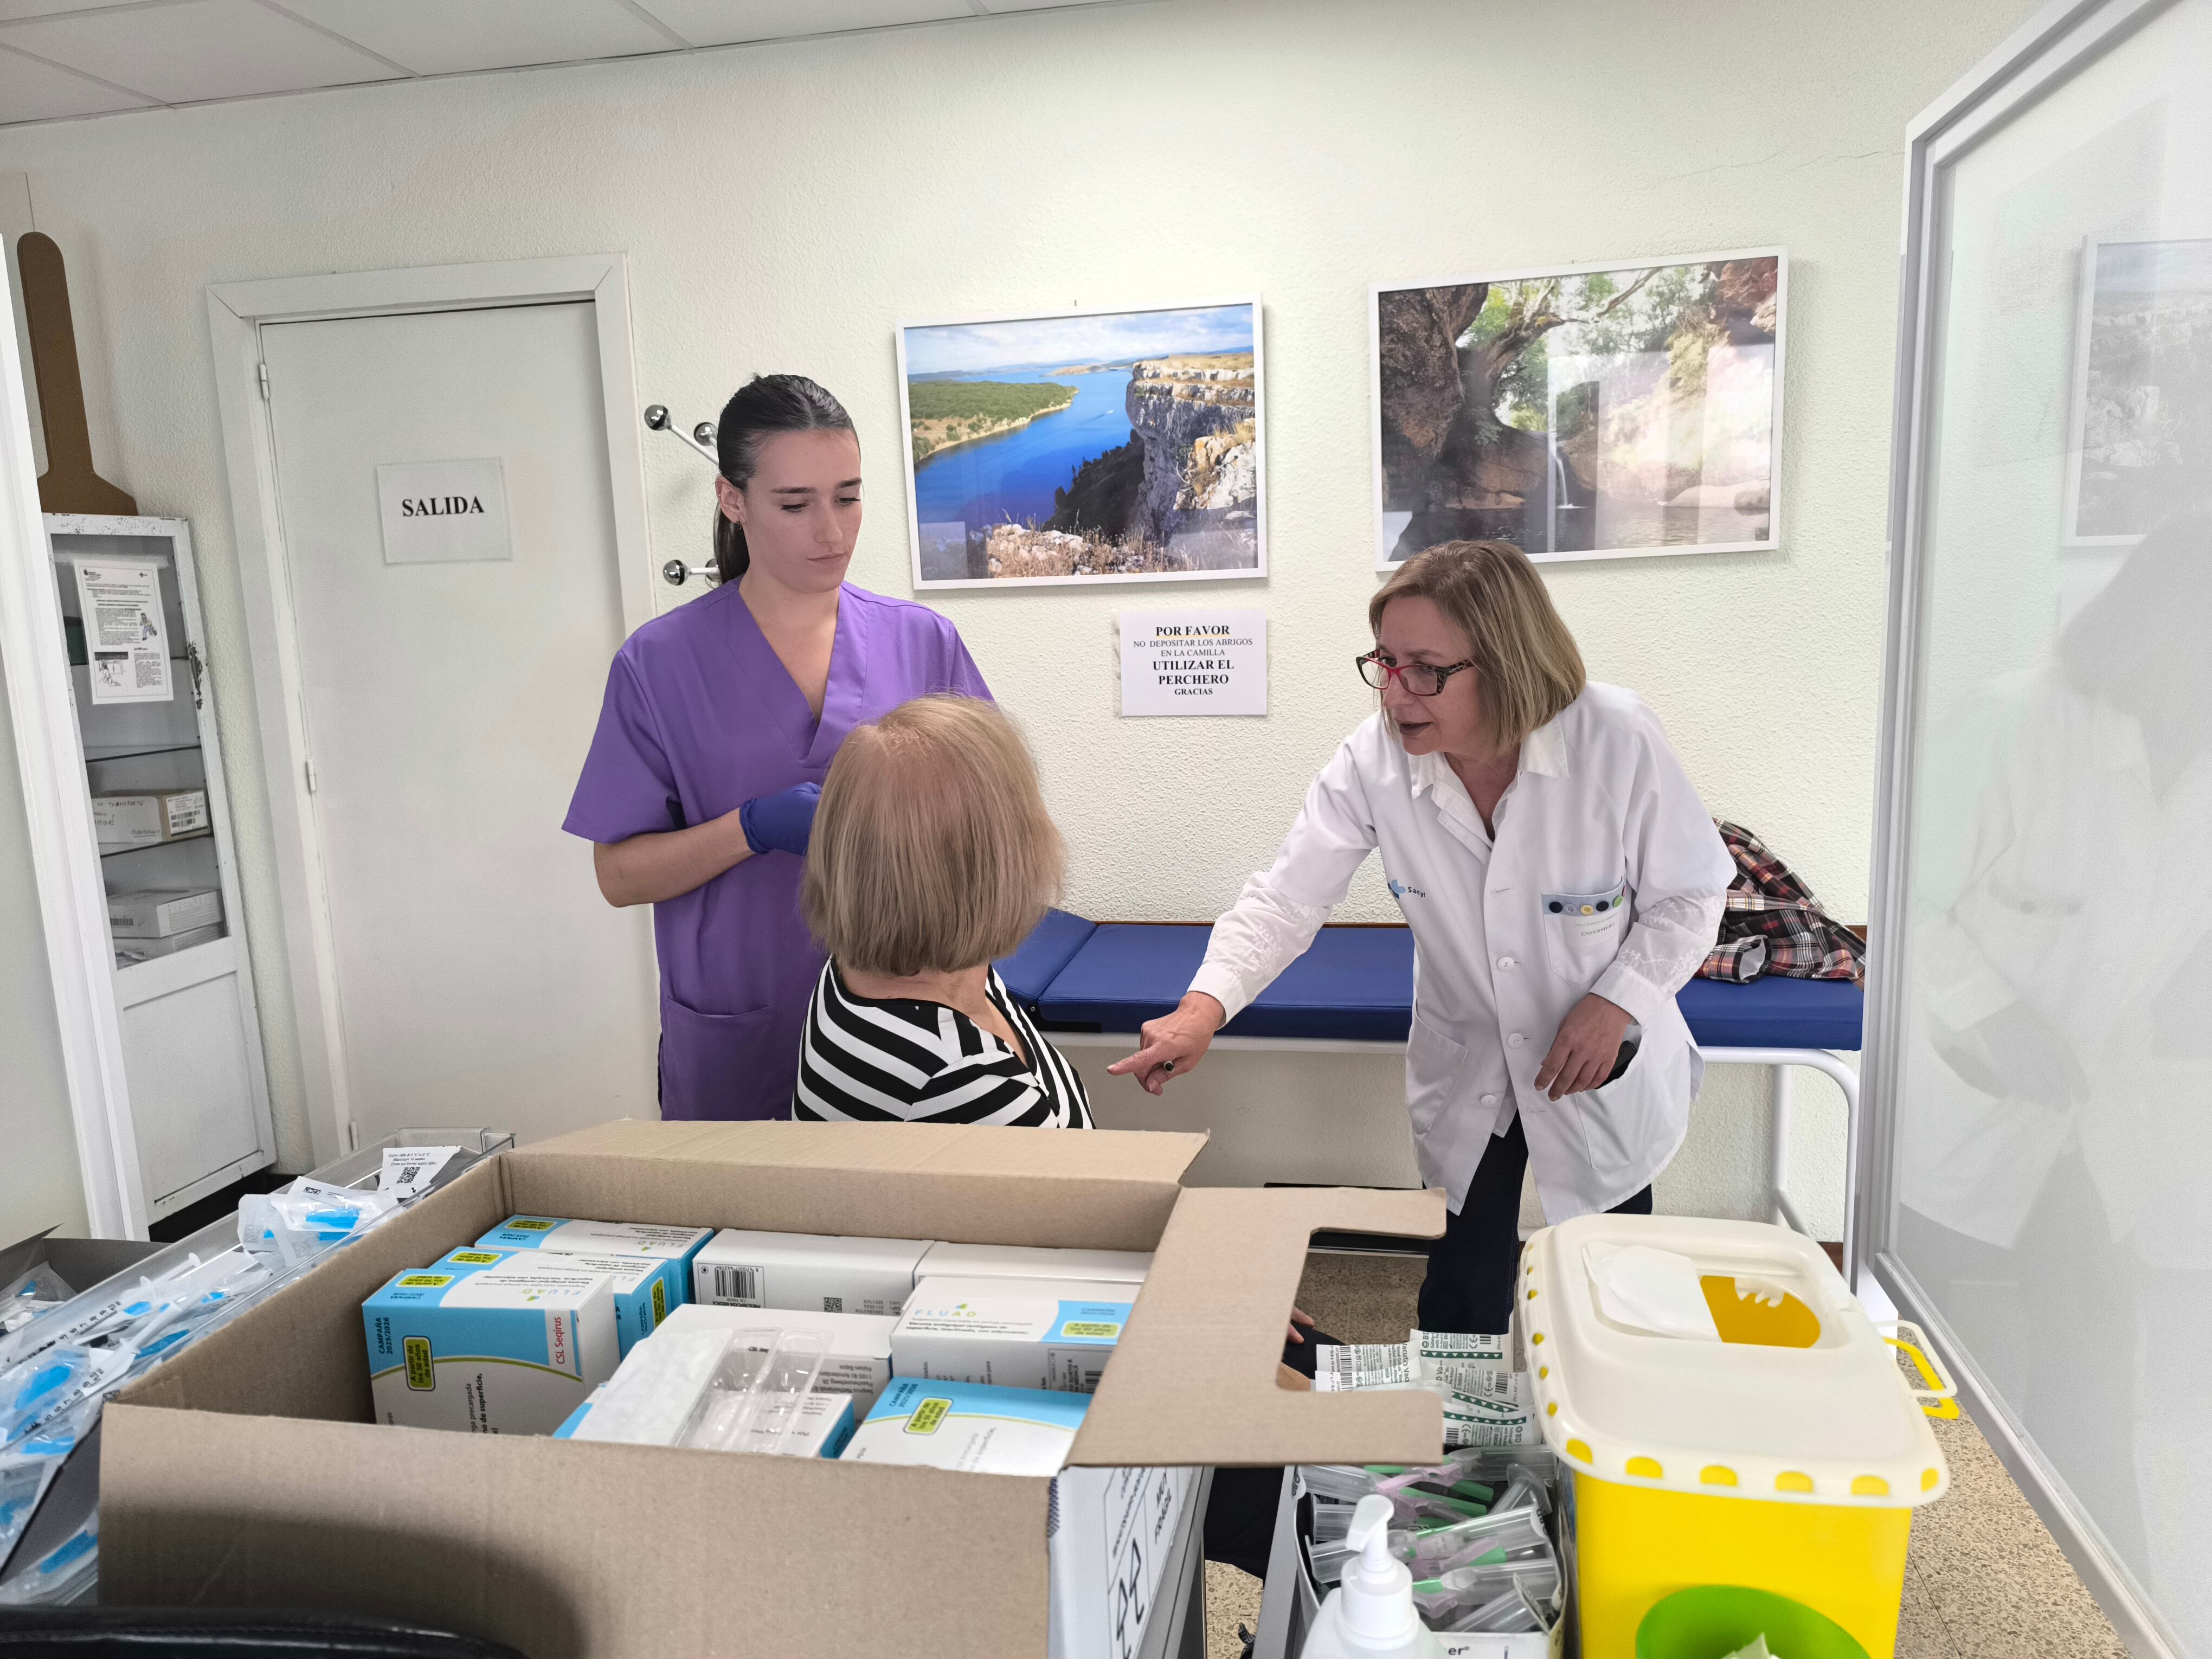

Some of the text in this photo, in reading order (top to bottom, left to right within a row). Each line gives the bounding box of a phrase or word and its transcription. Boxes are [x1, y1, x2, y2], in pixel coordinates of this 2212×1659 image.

[402, 495, 485, 517] SALIDA
[1155, 625, 1230, 636] POR FAVOR
[1153, 660, 1234, 670] UTILIZAR EL
[1159, 674, 1229, 685] PERCHERO
[1407, 886, 1426, 898] Sacyl
[1580, 923, 1615, 936] ENFERMERA
[915, 1309, 976, 1317] FLUAD
[375, 1317, 385, 1354] CAMPAÑA
[383, 1317, 393, 1355] 2025/2026
[554, 1316, 565, 1365] CSL Seqirus
[408, 1345, 414, 1354] de
[408, 1354, 417, 1375] partir
[417, 1362, 423, 1372] 50
[422, 1350, 430, 1378] de edad
[475, 1373, 486, 1412] superficie,
[465, 1383, 477, 1420] precargada
[480, 1413, 487, 1423] de
[1514, 1433, 1522, 1443] BD
